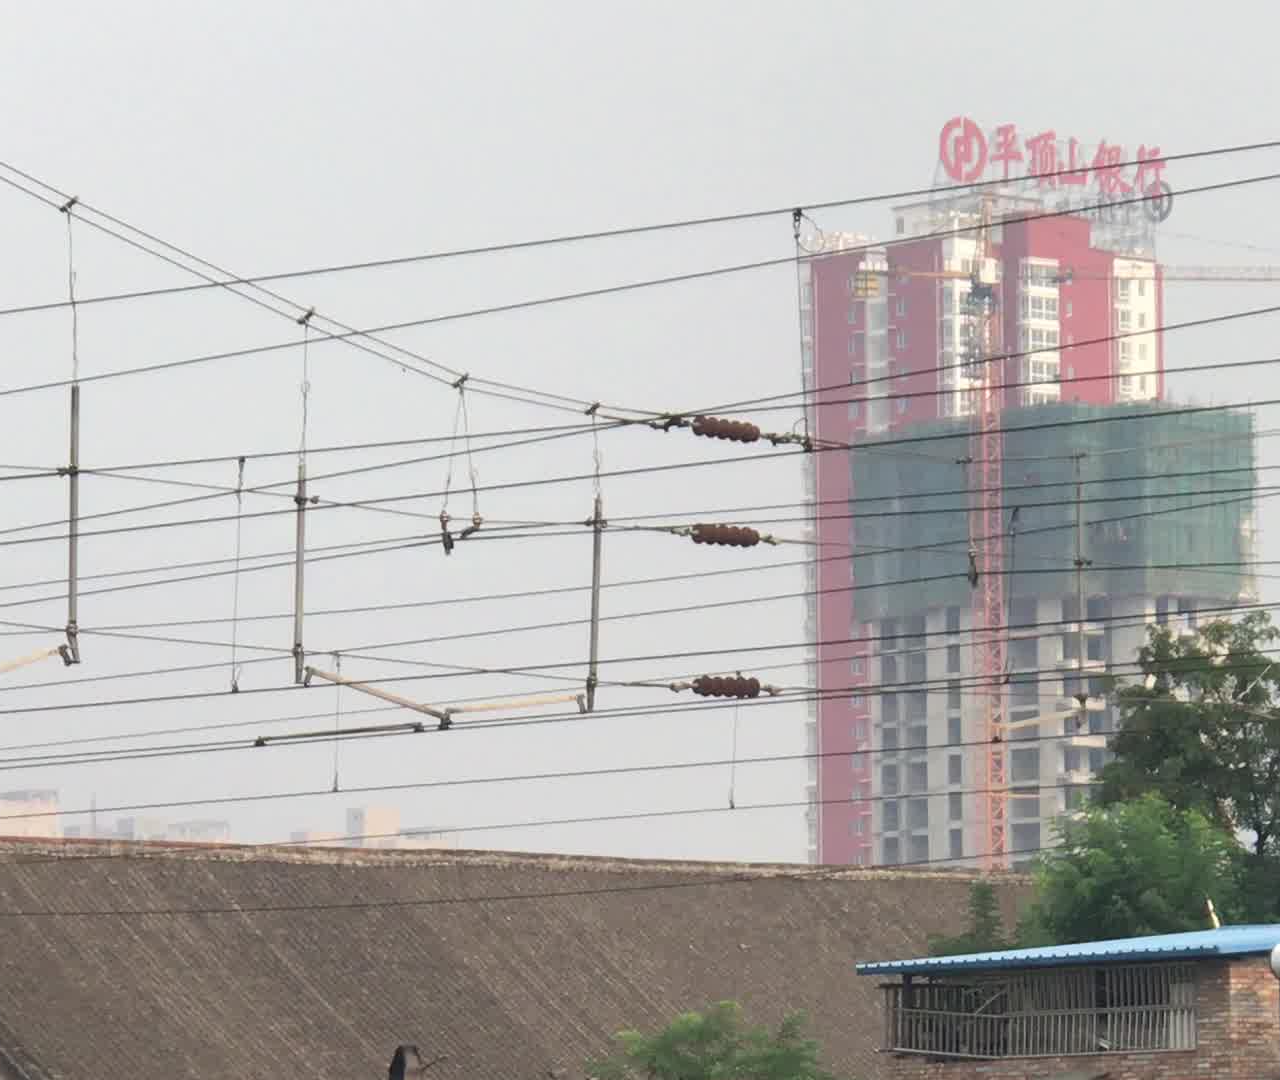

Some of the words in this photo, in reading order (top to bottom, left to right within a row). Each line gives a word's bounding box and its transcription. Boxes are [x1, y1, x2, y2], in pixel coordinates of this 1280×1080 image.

[990, 123, 1167, 198] 平顶山银行
